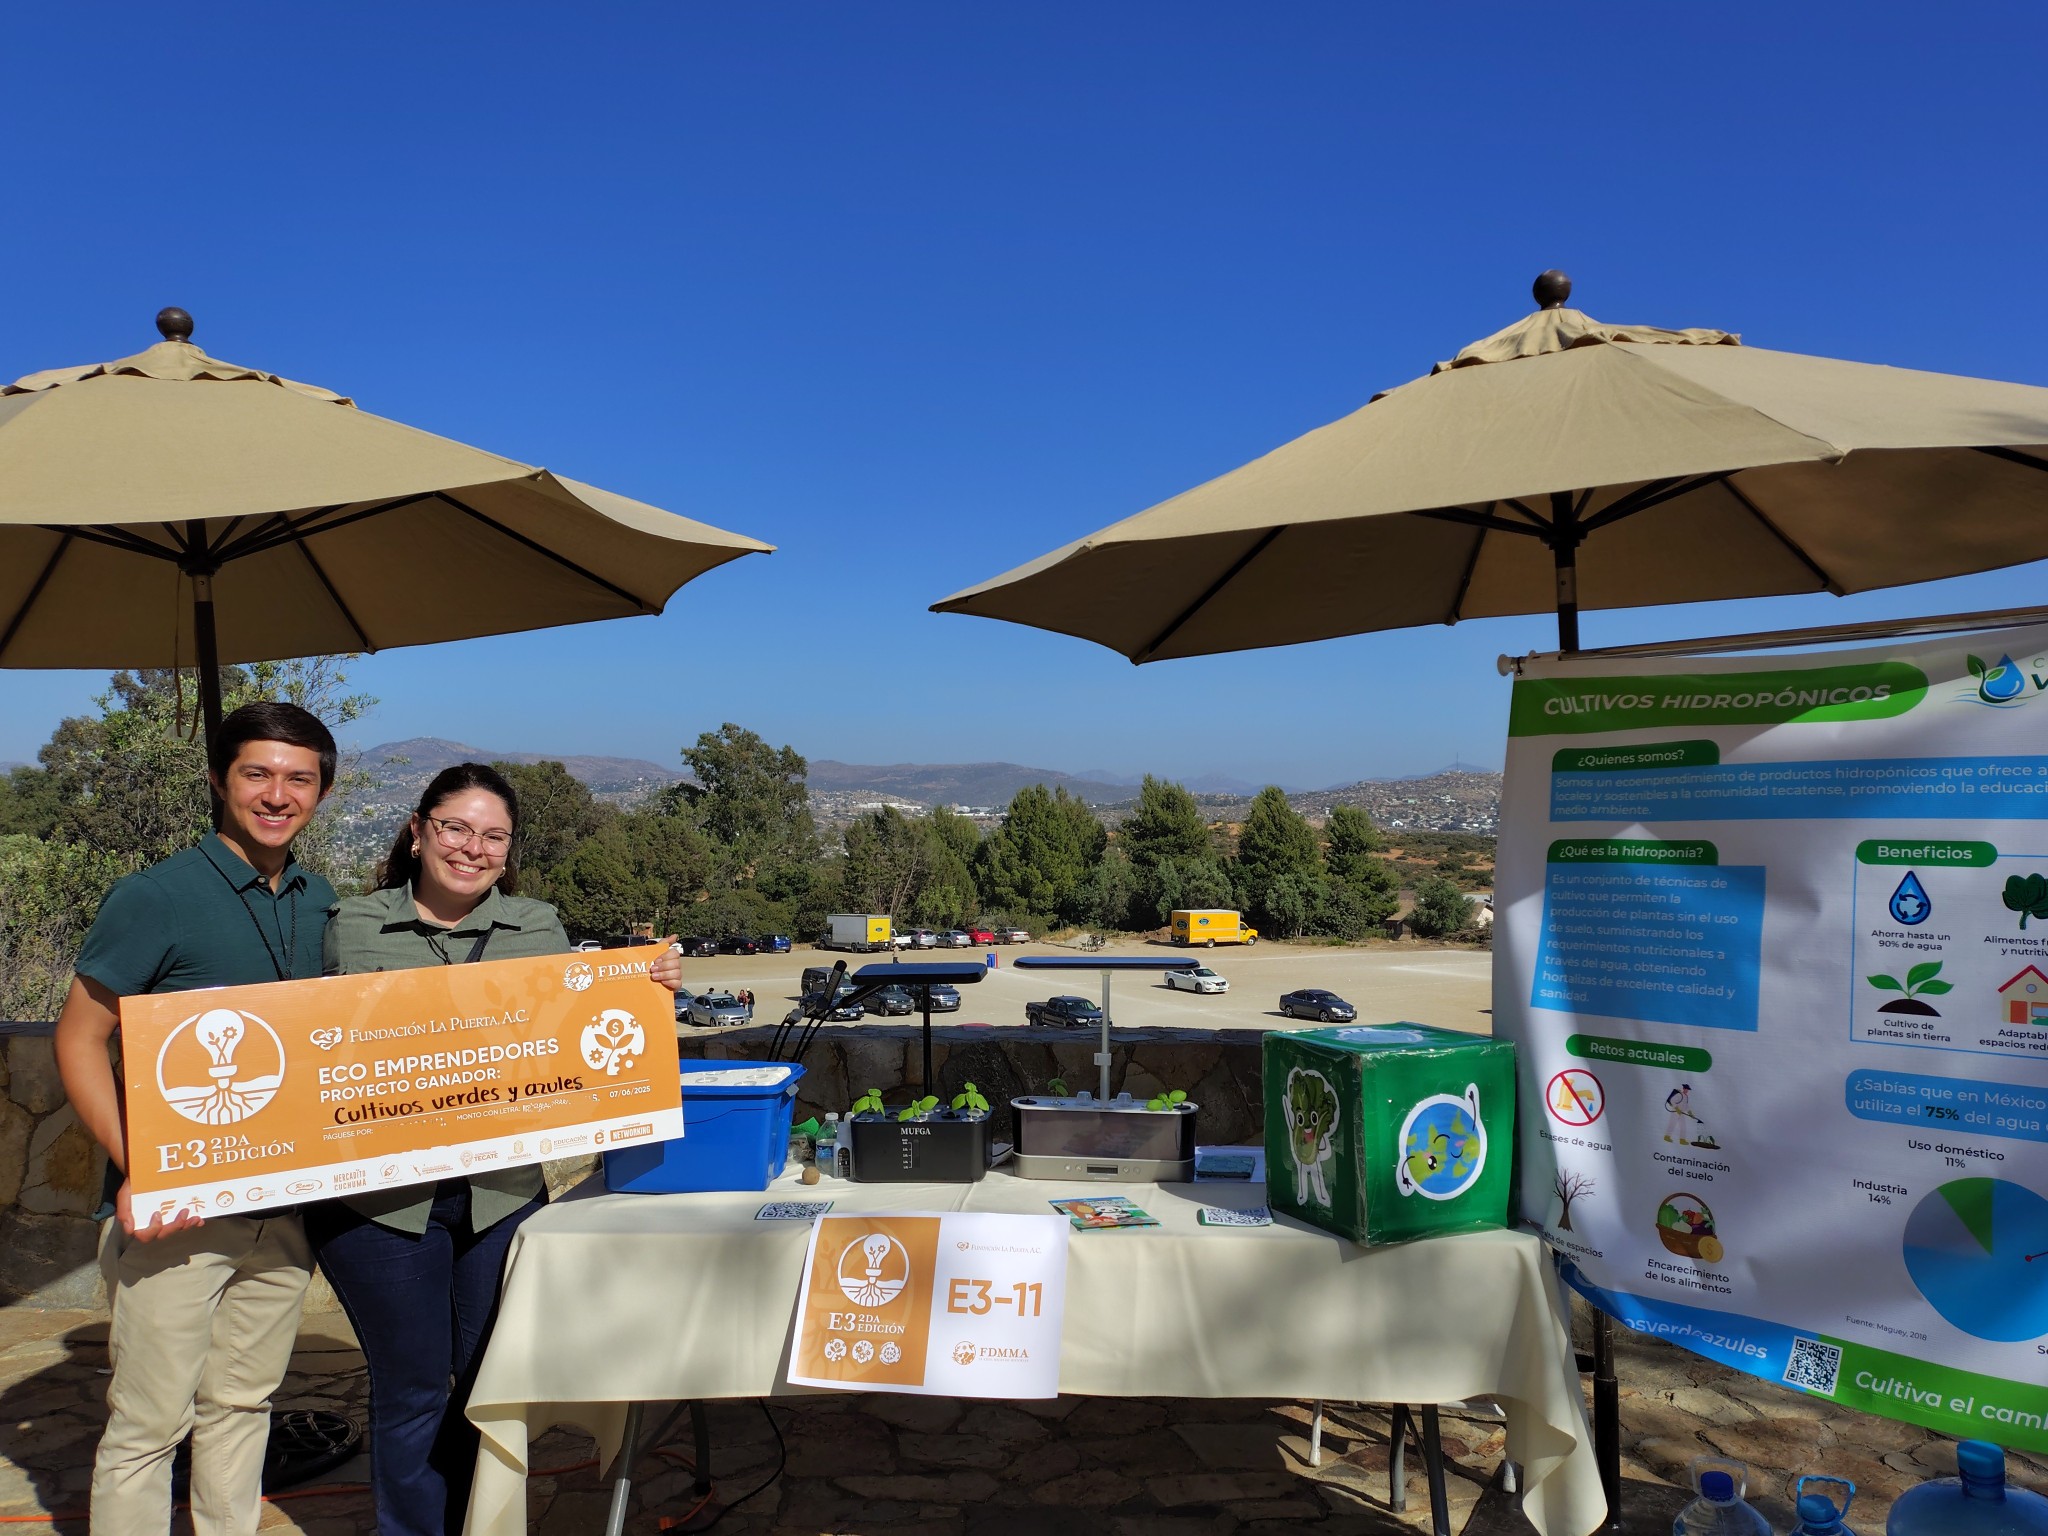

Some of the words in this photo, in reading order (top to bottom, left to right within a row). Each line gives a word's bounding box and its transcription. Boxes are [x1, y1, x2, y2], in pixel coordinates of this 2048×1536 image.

[1544, 693, 1655, 715] CULTIVOS
[1661, 685, 1891, 709] HIDROPÓNICOS
[1578, 754, 1635, 767] ¿Quienes
[1638, 750, 1685, 763] somos?
[1556, 777, 1594, 788] Somos
[1597, 776, 1613, 787] un
[1615, 770, 1736, 787] ecoemprendimiento
[1739, 770, 1756, 781] de
[1759, 767, 1831, 784] productos
[1836, 765, 1938, 779] hidropónicos
[1941, 765, 1974, 779] que
[1978, 763, 2033, 777] ofrece
[1555, 792, 1592, 801] locales
[1604, 789, 1668, 801] sostenibles
[1671, 790, 1678, 799] a
[1680, 788, 1692, 799] la
[1694, 785, 1768, 798] comunidad
[1772, 783, 1846, 796] tecatense,
[1850, 781, 1956, 797] promoviendo
[1961, 781, 1976, 793] la
[1555, 805, 1588, 814] medio
[1590, 804, 1652, 815] ambiente.
[1559, 846, 1588, 858] ¿Qué
[1591, 846, 1604, 855] es
[1607, 846, 1619, 856] la
[1622, 846, 1704, 859] hidroponía?
[1877, 845, 1972, 860] Beneficios
[1553, 875, 1565, 884] Es
[1567, 875, 1580, 884] un
[1583, 875, 1632, 886] conjunto
[1635, 876, 1650, 885] de
[1654, 876, 1707, 888] técnicas
[1711, 878, 1727, 889] de
[1551, 891, 1585, 900] cultivo
[1587, 893, 1608, 904] que
[1611, 893, 1666, 905] permiten
[1670, 894, 1681, 904] la
[1550, 908, 1609, 919] producción
[1612, 908, 1627, 919] de
[1630, 910, 1674, 922] plantas
[1678, 911, 1695, 922] sin
[1700, 912, 1711, 922] el
[1714, 915, 1738, 924] uso
[1548, 923, 1563, 932] de
[1565, 923, 1595, 934] suelo,
[1597, 925, 1683, 940] suministrando
[1686, 929, 1704, 940] los
[1871, 929, 1905, 939] Ahorra
[1907, 932, 1935, 940] hasta
[1878, 940, 1899, 948] 90%
[1902, 941, 1914, 949] de
[1917, 942, 1942, 951] agua
[1984, 936, 2039, 945] Alimentos
[1546, 939, 1631, 954] requerimientos
[1633, 944, 1713, 959] nutricionales
[1717, 950, 1725, 960] a
[1545, 955, 1580, 967] través
[1582, 956, 1598, 967] del
[1600, 960, 1631, 972] agua,
[1634, 962, 1706, 976] obteniendo
[1542, 971, 1597, 986] hortalizas
[1599, 975, 1613, 986] de
[1615, 978, 1674, 992] excelente
[1677, 982, 1724, 996] calidad
[1727, 987, 1735, 999] y
[1540, 987, 1590, 1002] sanidad.
[350, 1022, 426, 1043] FUNDACIÓN
[430, 1020, 447, 1033] LA
[501, 1009, 530, 1025] A.C.
[1884, 1019, 1919, 1029] Cultivo
[1921, 1022, 1934, 1030] de
[1867, 1028, 1904, 1038] plantas
[1906, 1031, 1920, 1040] sin
[1923, 1033, 1950, 1042] tierra
[1979, 1039, 2025, 1049] espacios
[319, 1063, 367, 1085] ECO
[375, 1037, 559, 1077] EMPRENDEDORES
[1590, 1042, 1625, 1057] Retos
[1627, 1048, 1685, 1064] actuales
[320, 1080, 410, 1103] PROYECTO
[416, 1068, 501, 1089] GANADOR:
[609, 1085, 650, 1098] 07/06/2025
[334, 1101, 424, 1125] Cultivos
[431, 1086, 500, 1109] verdes
[508, 1086, 518, 1103] y
[524, 1073, 584, 1097] azules
[1855, 1078, 1916, 1095] ¿Sabías
[1920, 1086, 1953, 1100] que
[1957, 1090, 1979, 1101] en
[1985, 1091, 2046, 1110] México
[457, 1113, 481, 1121] MONTO
[500, 1106, 521, 1115] LETRA:
[1855, 1099, 1901, 1113] utiliza
[1907, 1104, 1921, 1116] el
[1925, 1106, 1960, 1121] 75%
[1964, 1111, 1991, 1124] del
[1995, 1118, 2040, 1131] agua
[323, 1130, 355, 1141] PÁGUESE
[356, 1128, 373, 1136] POR:
[553, 1135, 587, 1145] EDUCACIÓN
[613, 1126, 651, 1139] NETWORKING
[211, 1134, 250, 1150] 2DA
[1572, 1138, 1584, 1146] de
[1588, 1141, 1612, 1151] agua
[156, 1138, 208, 1173] E3
[212, 1140, 295, 1165] EDICIÓN
[474, 1153, 498, 1162] TECATE
[1908, 1140, 1931, 1151] Uso
[1935, 1143, 2005, 1161] doméstico
[1653, 1152, 1731, 1172] Contaminación
[1945, 1157, 1966, 1168] 11%
[1668, 1166, 1684, 1177] del
[1686, 1170, 1714, 1182] suelo
[335, 1179, 366, 1191] CUCHUMA
[1853, 1179, 1908, 1195] Industria
[1869, 1194, 1891, 1205] 14%
[1556, 1237, 1564, 1246] de
[1567, 1242, 1603, 1258] espacios
[1647, 1259, 1729, 1283] Encarecimiento
[1645, 1270, 1658, 1280] de
[1661, 1272, 1676, 1284] los
[1678, 1276, 1732, 1294] alimentos
[947, 1278, 1042, 1316] E3-11
[827, 1312, 855, 1331] E3
[858, 1315, 880, 1323] 2DA
[858, 1322, 905, 1334] EDICIÓN
[1846, 1316, 1875, 1328] Fuente:
[1876, 1323, 1908, 1337] Maguey,
[1910, 1331, 1927, 1341] 2018
[980, 1348, 1028, 1358] FDMMA
[1856, 1371, 1942, 1408] Cultiva
[1950, 1397, 1975, 1415] el
